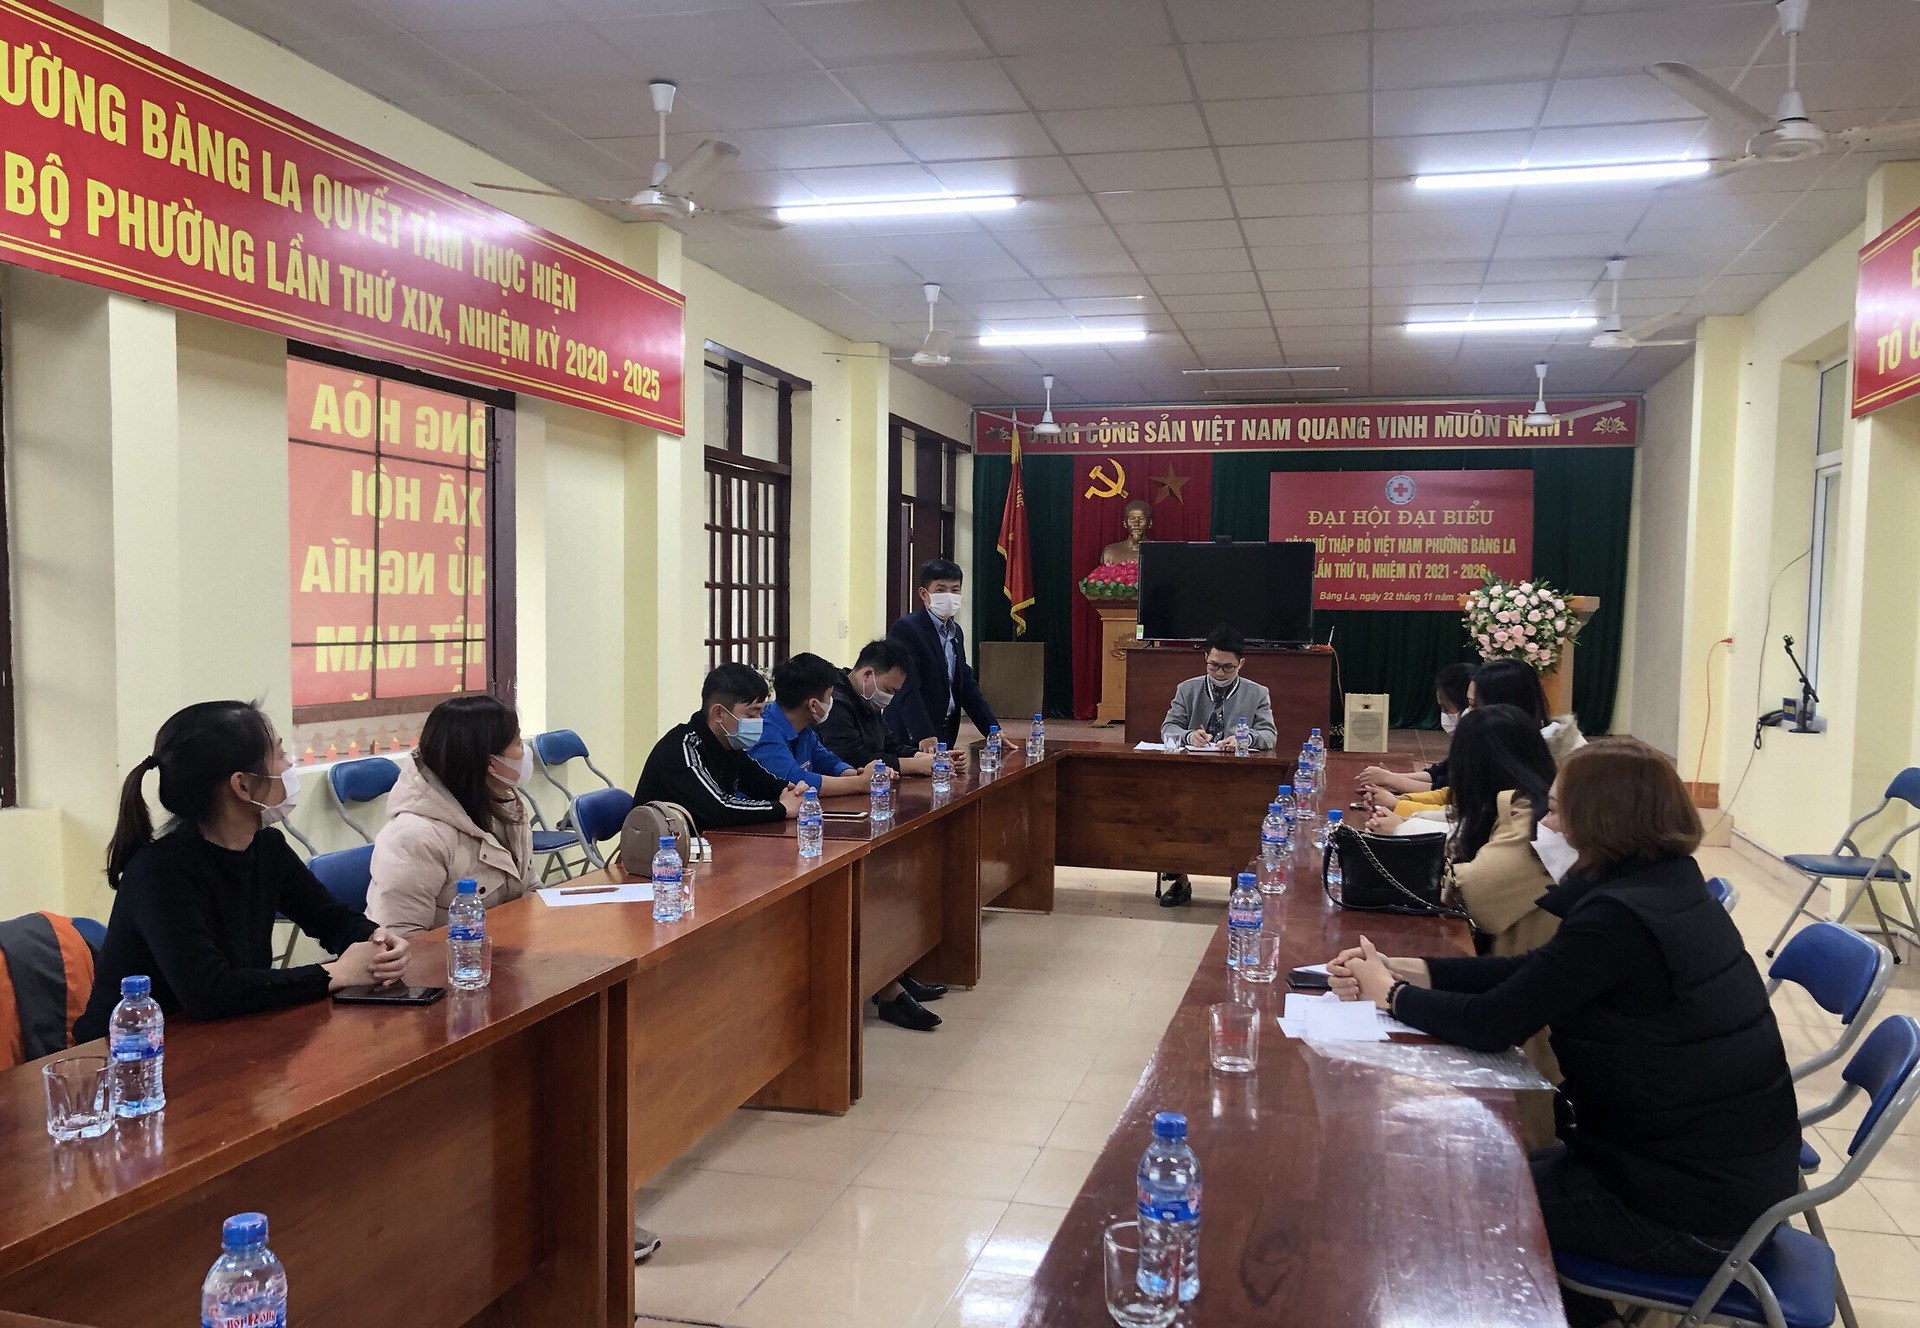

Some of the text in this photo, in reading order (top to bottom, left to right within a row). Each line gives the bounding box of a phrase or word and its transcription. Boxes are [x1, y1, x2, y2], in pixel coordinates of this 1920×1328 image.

[142, 100, 250, 193] BÀNG
[262, 150, 303, 213] LA
[312, 173, 403, 249] QUYẾT
[410, 211, 463, 272] TÂM
[471, 237, 525, 298] THỰC
[532, 261, 577, 315] HIỆN
[4, 150, 660, 402] BỘ PHƯỜNG LẦN THỨ XIX, NHIỆM KỲ 2020 - 2025
[1085, 416, 1139, 448] CỘNG
[1144, 413, 1186, 443] SẢN
[1193, 414, 1235, 446] VIỆT
[1241, 418, 1291, 441] NAM
[1297, 415, 1370, 443] QUANG
[1377, 415, 1428, 439] VINH
[1434, 409, 1500, 438] MUÔN
[1308, 500, 1495, 529] ĐẠI HỘI ĐẠI BIỂU
[1305, 532, 1516, 556] HỮ THẬP ĐỎ VIỆT NAM PHƯỜNG BÀNG LA
[1315, 558, 1331, 578] ẦN
[1335, 560, 1355, 578] THỨ
[1372, 560, 1405, 581] NHIỆM
[1408, 560, 1422, 578] KỲ
[1425, 564, 1449, 578] 2021
[1320, 591, 1342, 602] Bàng
[1345, 592, 1357, 601] La,
[1360, 592, 1381, 603] ngày
[1383, 592, 1394, 600] 22
[1395, 592, 1421, 603] tháng
[1424, 592, 1433, 600] 11
